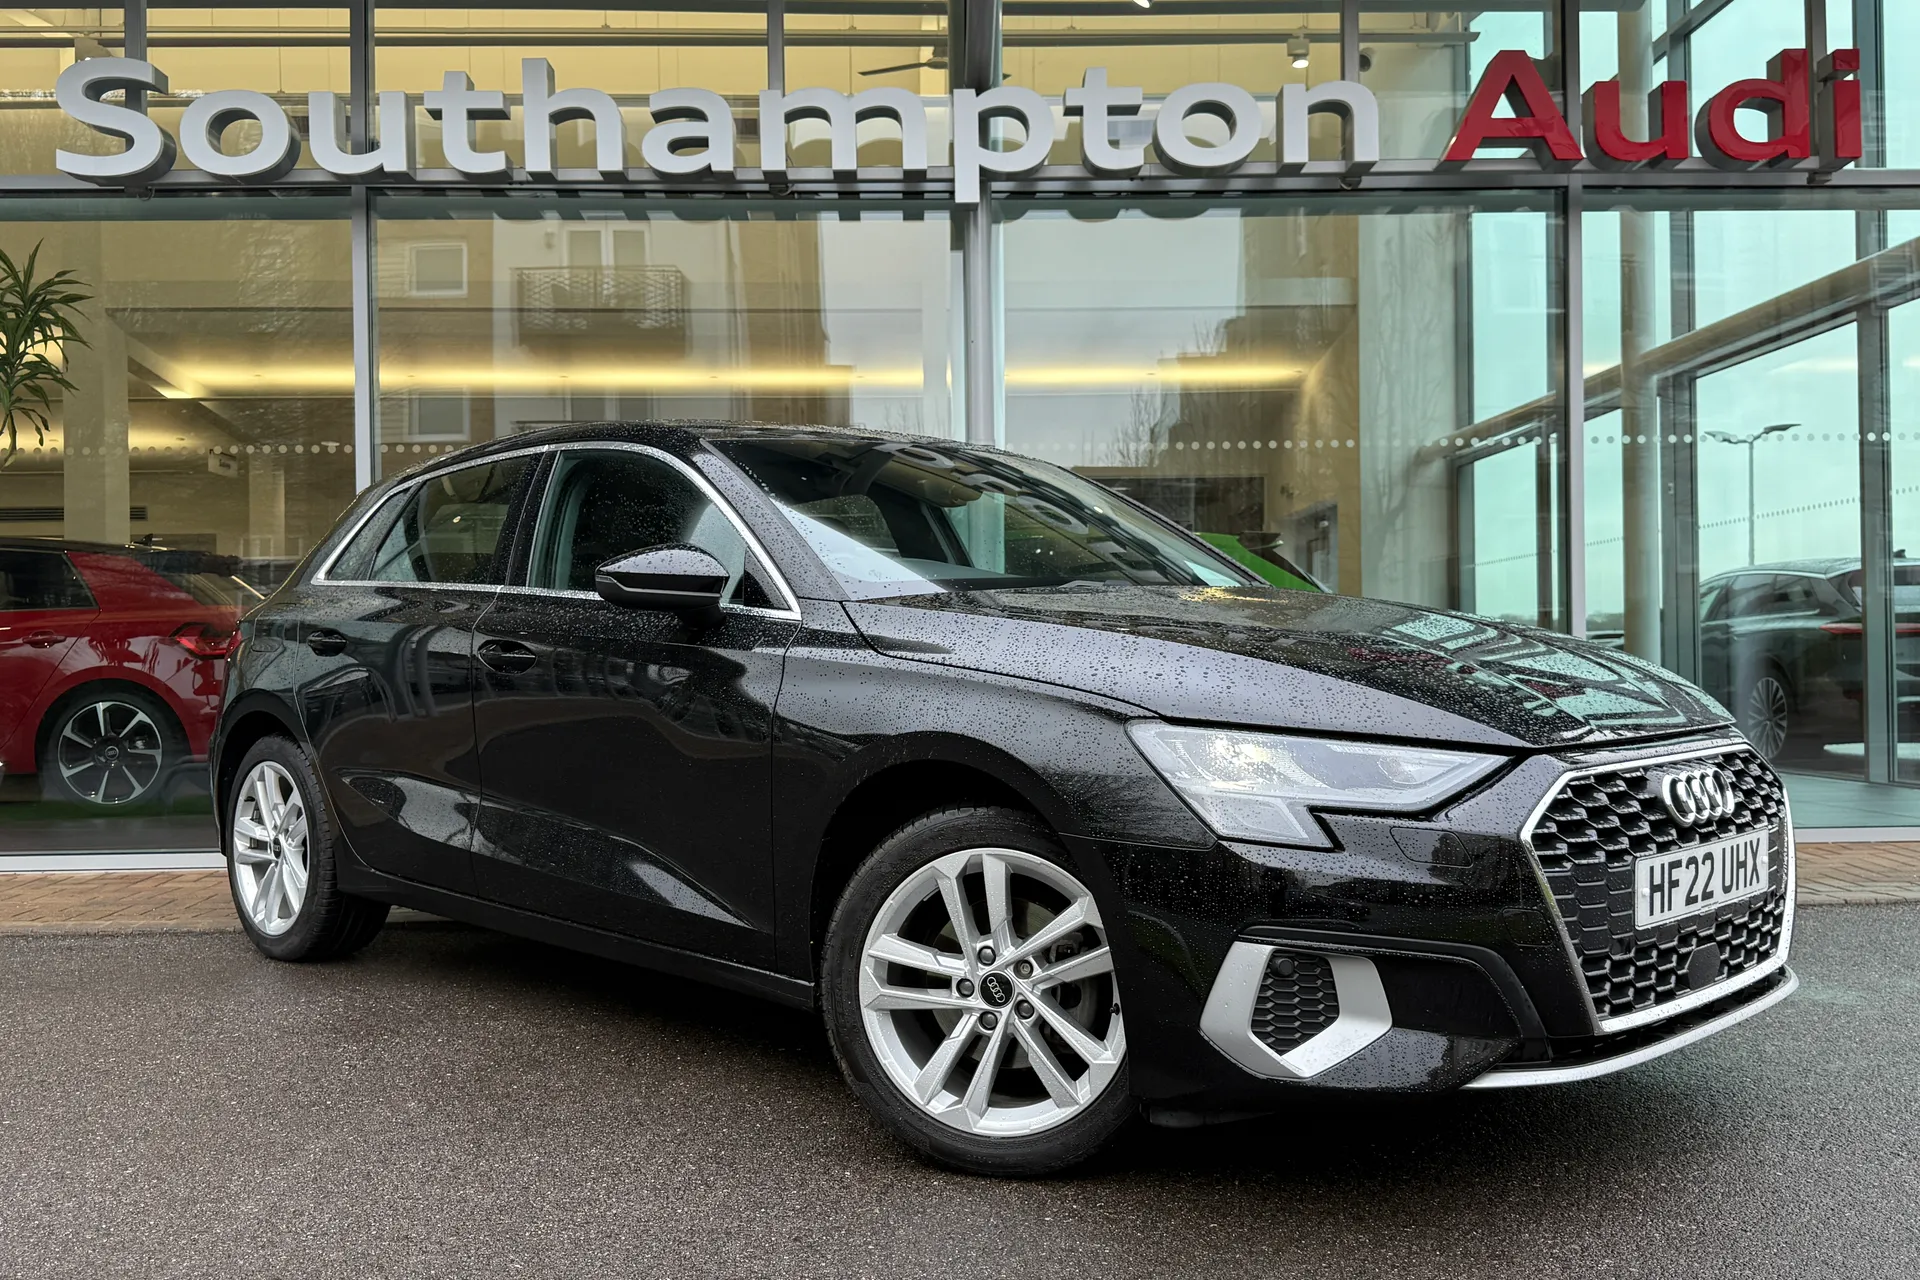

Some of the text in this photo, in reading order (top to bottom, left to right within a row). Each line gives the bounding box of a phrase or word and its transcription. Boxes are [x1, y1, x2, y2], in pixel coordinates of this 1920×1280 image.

[55, 48, 1862, 204] Southampton Audi
[1649, 837, 1760, 917] HF22 UHX
